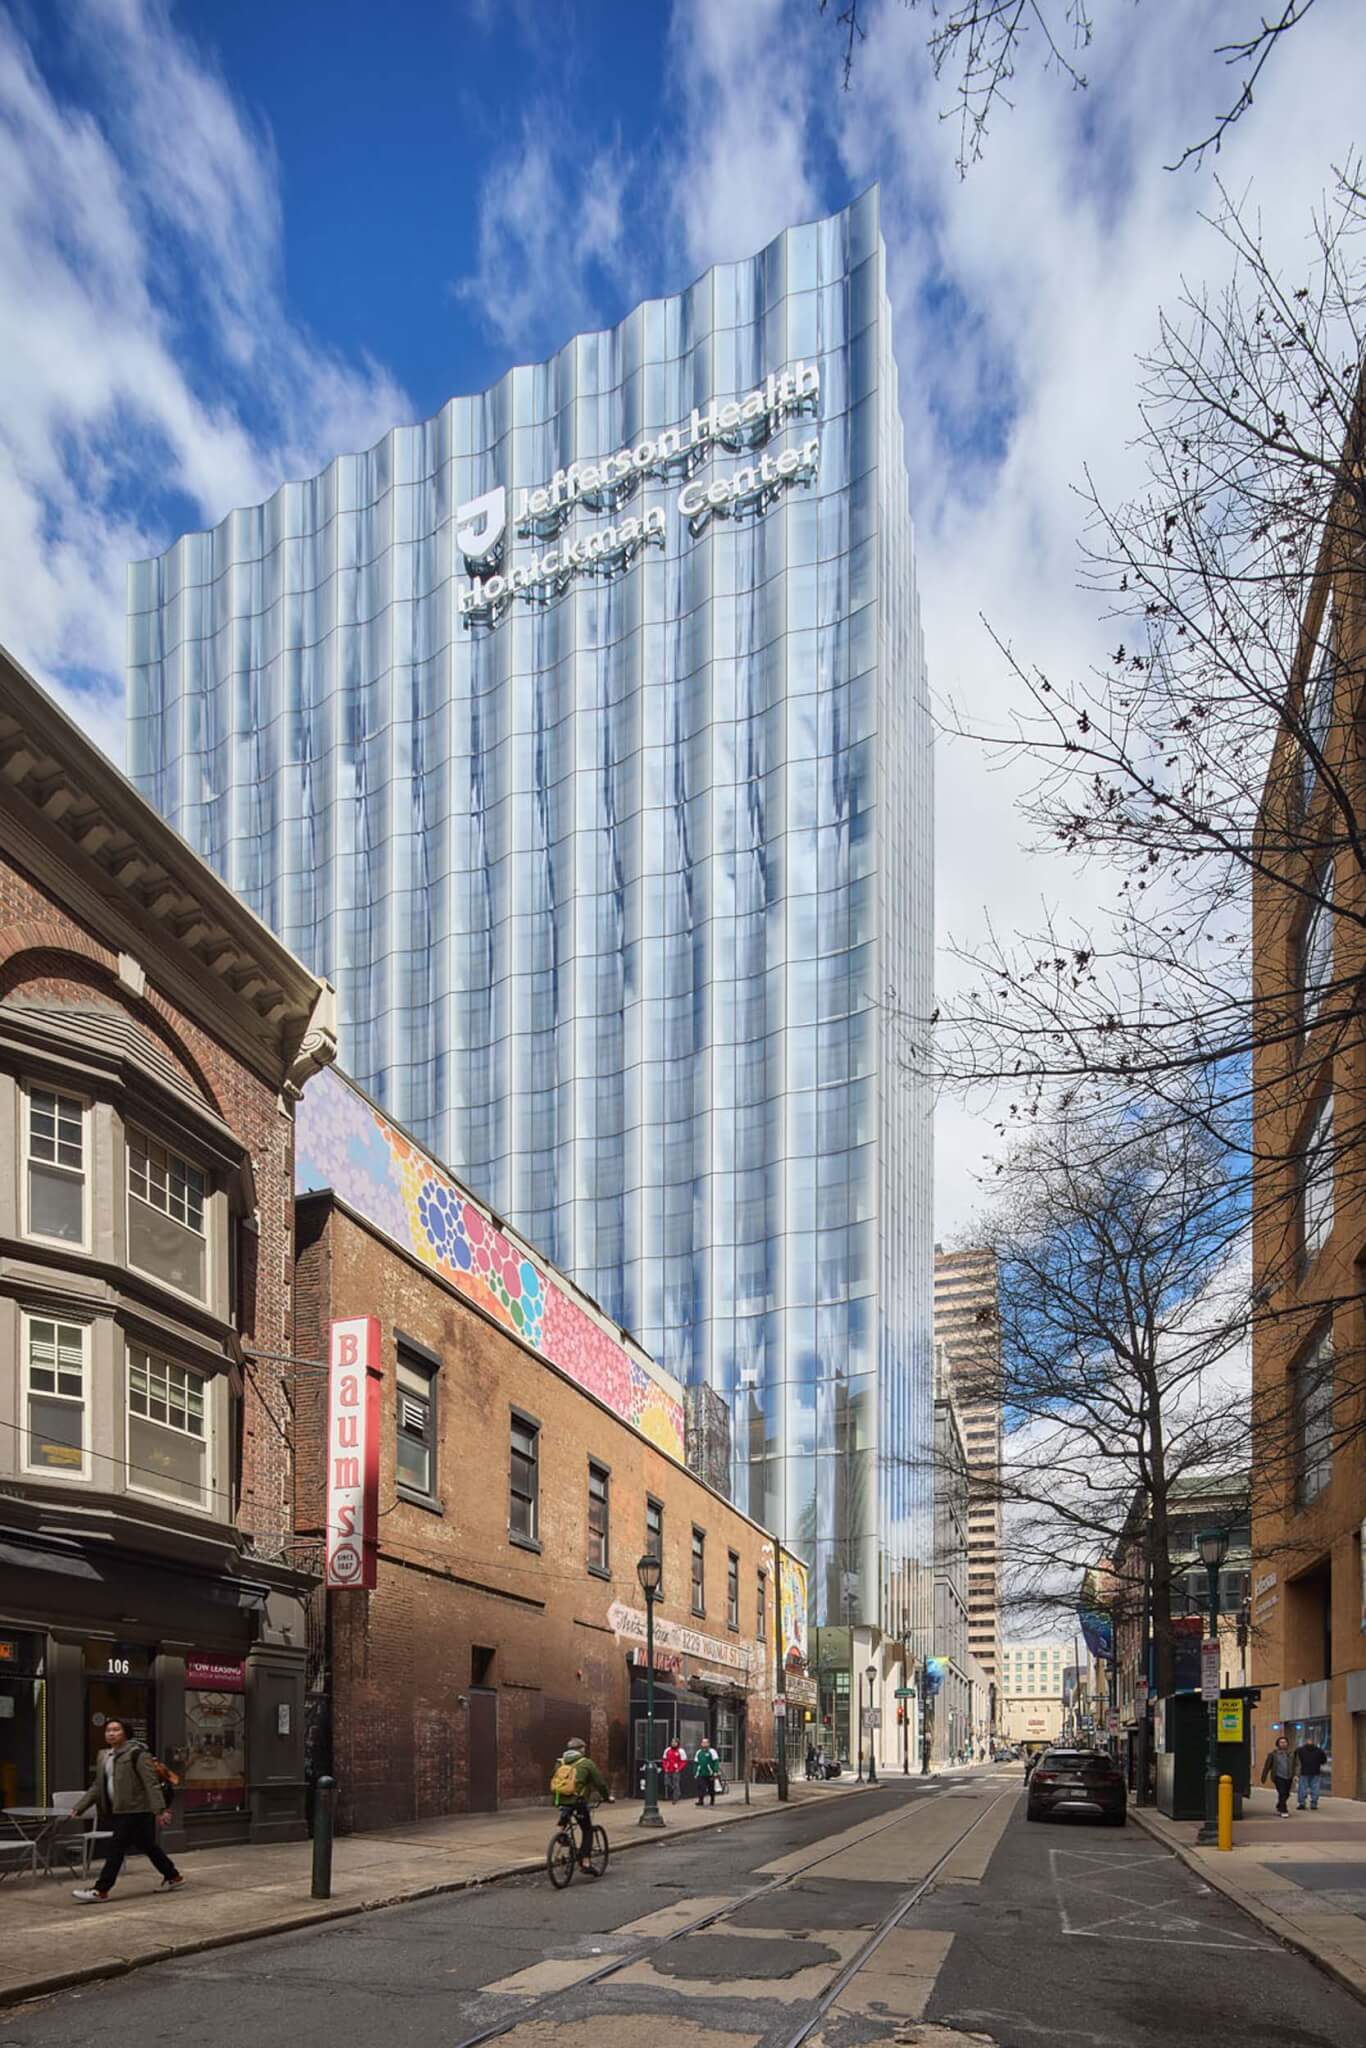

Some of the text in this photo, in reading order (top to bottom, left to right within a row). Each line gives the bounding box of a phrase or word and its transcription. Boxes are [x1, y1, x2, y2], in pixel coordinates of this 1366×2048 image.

[458, 436, 820, 614] Honickman Center
[514, 359, 820, 525] Jefferson Health
[107, 1658, 129, 1674] 106
